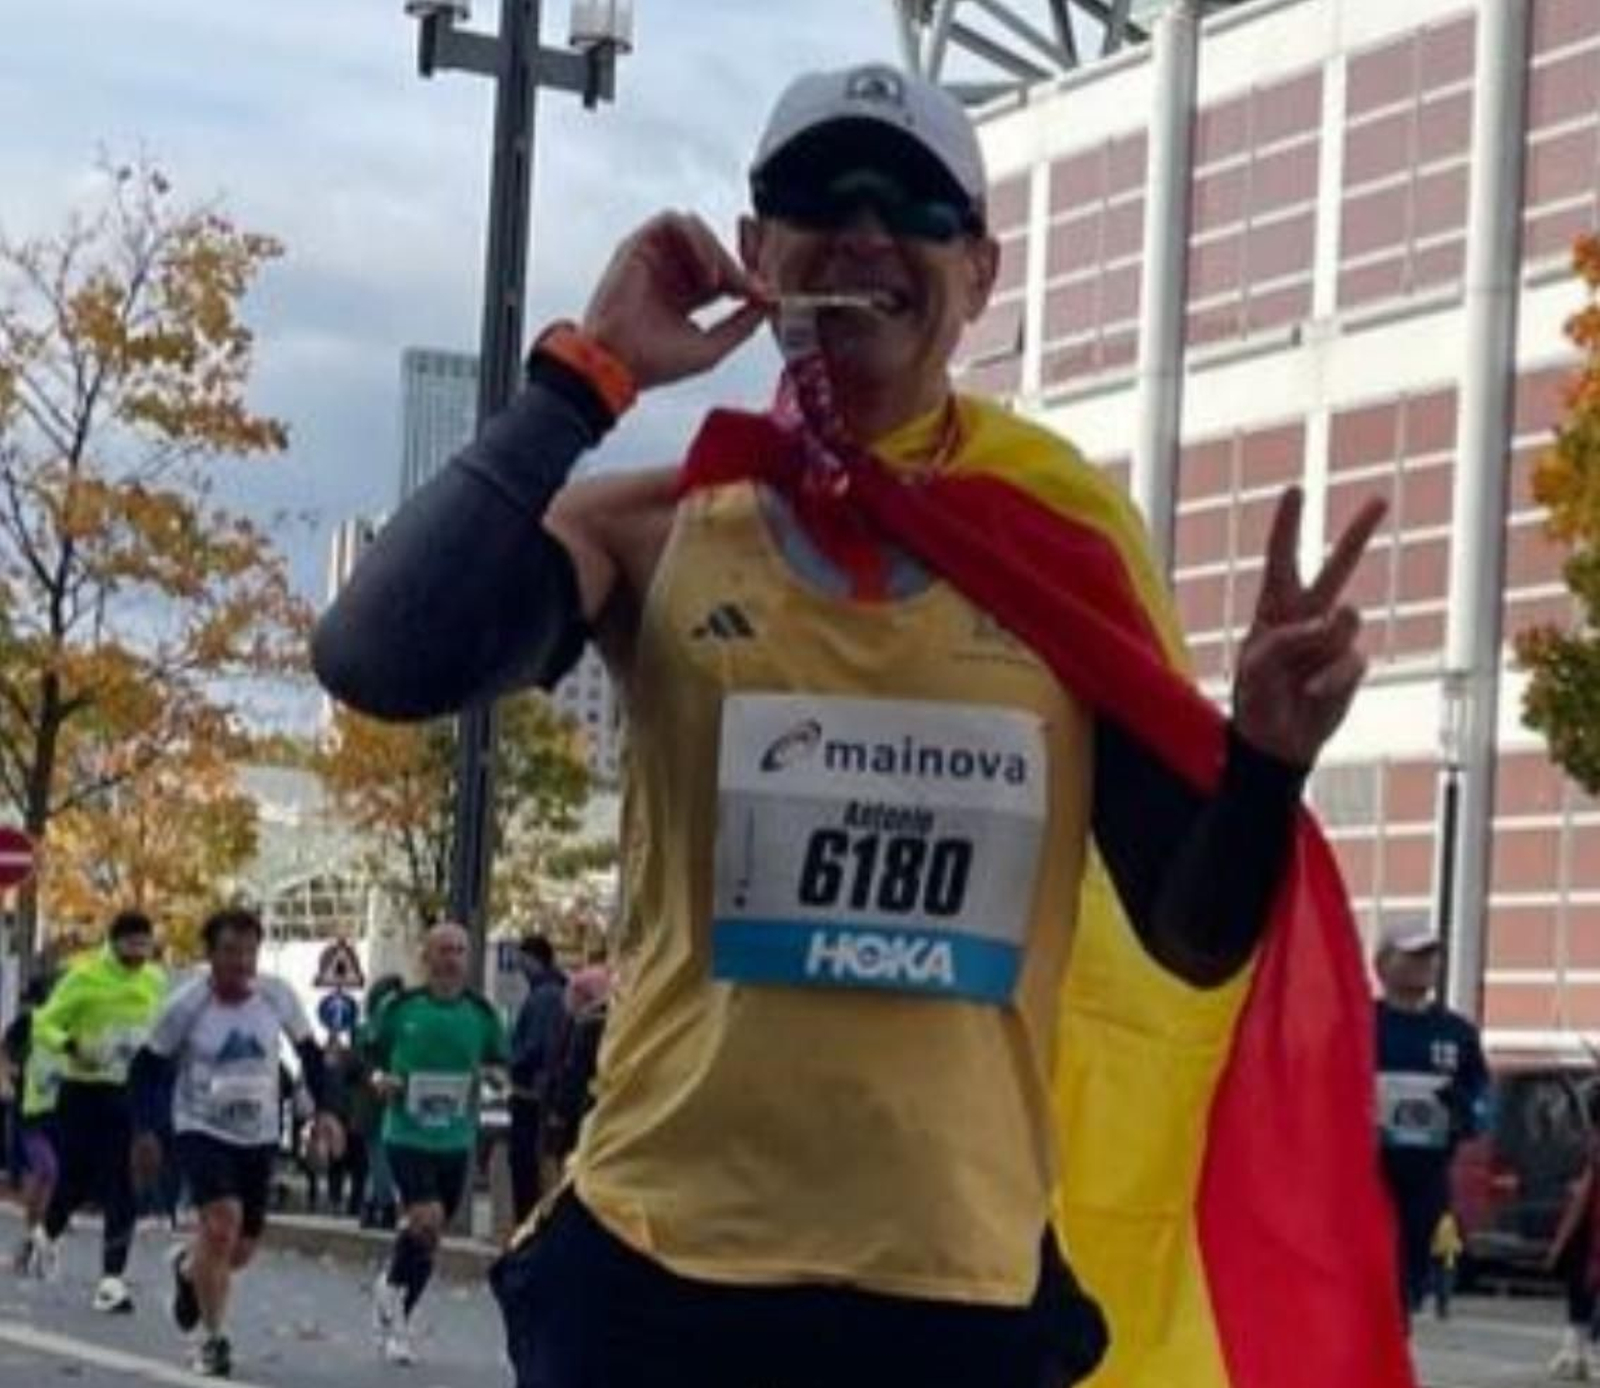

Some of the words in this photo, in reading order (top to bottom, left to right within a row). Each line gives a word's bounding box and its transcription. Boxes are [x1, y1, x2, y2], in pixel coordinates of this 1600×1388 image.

[824, 737, 1027, 786] mainova
[798, 829, 974, 917] 6180
[805, 930, 955, 985] HOKA
